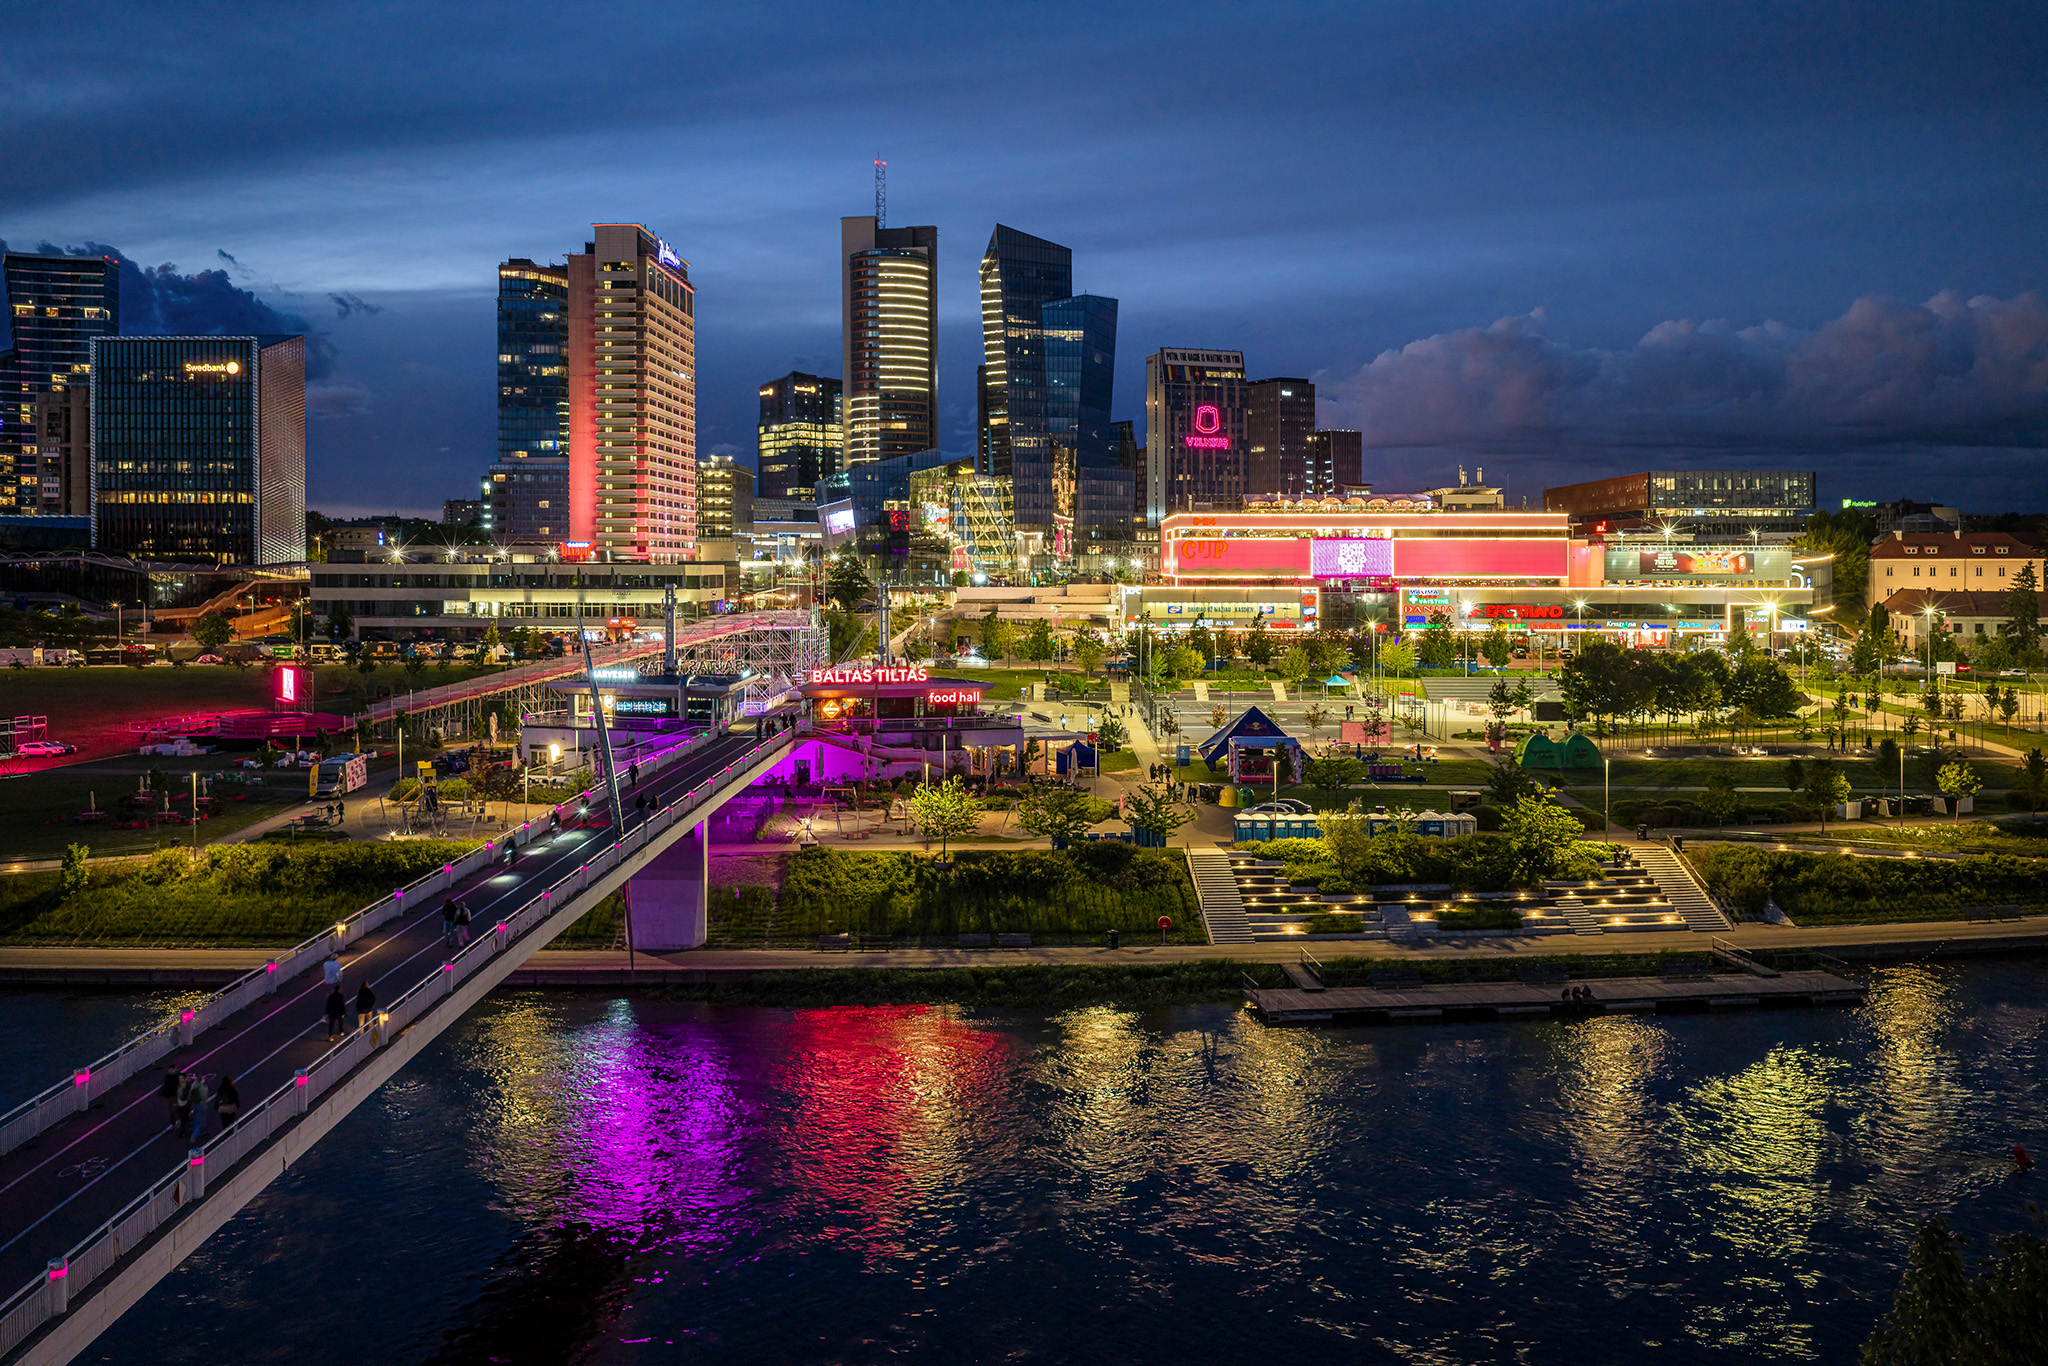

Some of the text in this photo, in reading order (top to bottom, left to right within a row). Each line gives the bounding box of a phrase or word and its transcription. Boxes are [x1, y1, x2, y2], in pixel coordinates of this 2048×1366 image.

[185, 363, 227, 372] Swedbank
[1185, 436, 1229, 448] VILNIUS
[1181, 540, 1229, 559] CUP
[1340, 548, 1365, 557] PINK
[1485, 605, 1563, 618] SPORTLAND
[812, 668, 928, 683] BALTAS TILTAS
[929, 691, 980, 703] food hall
